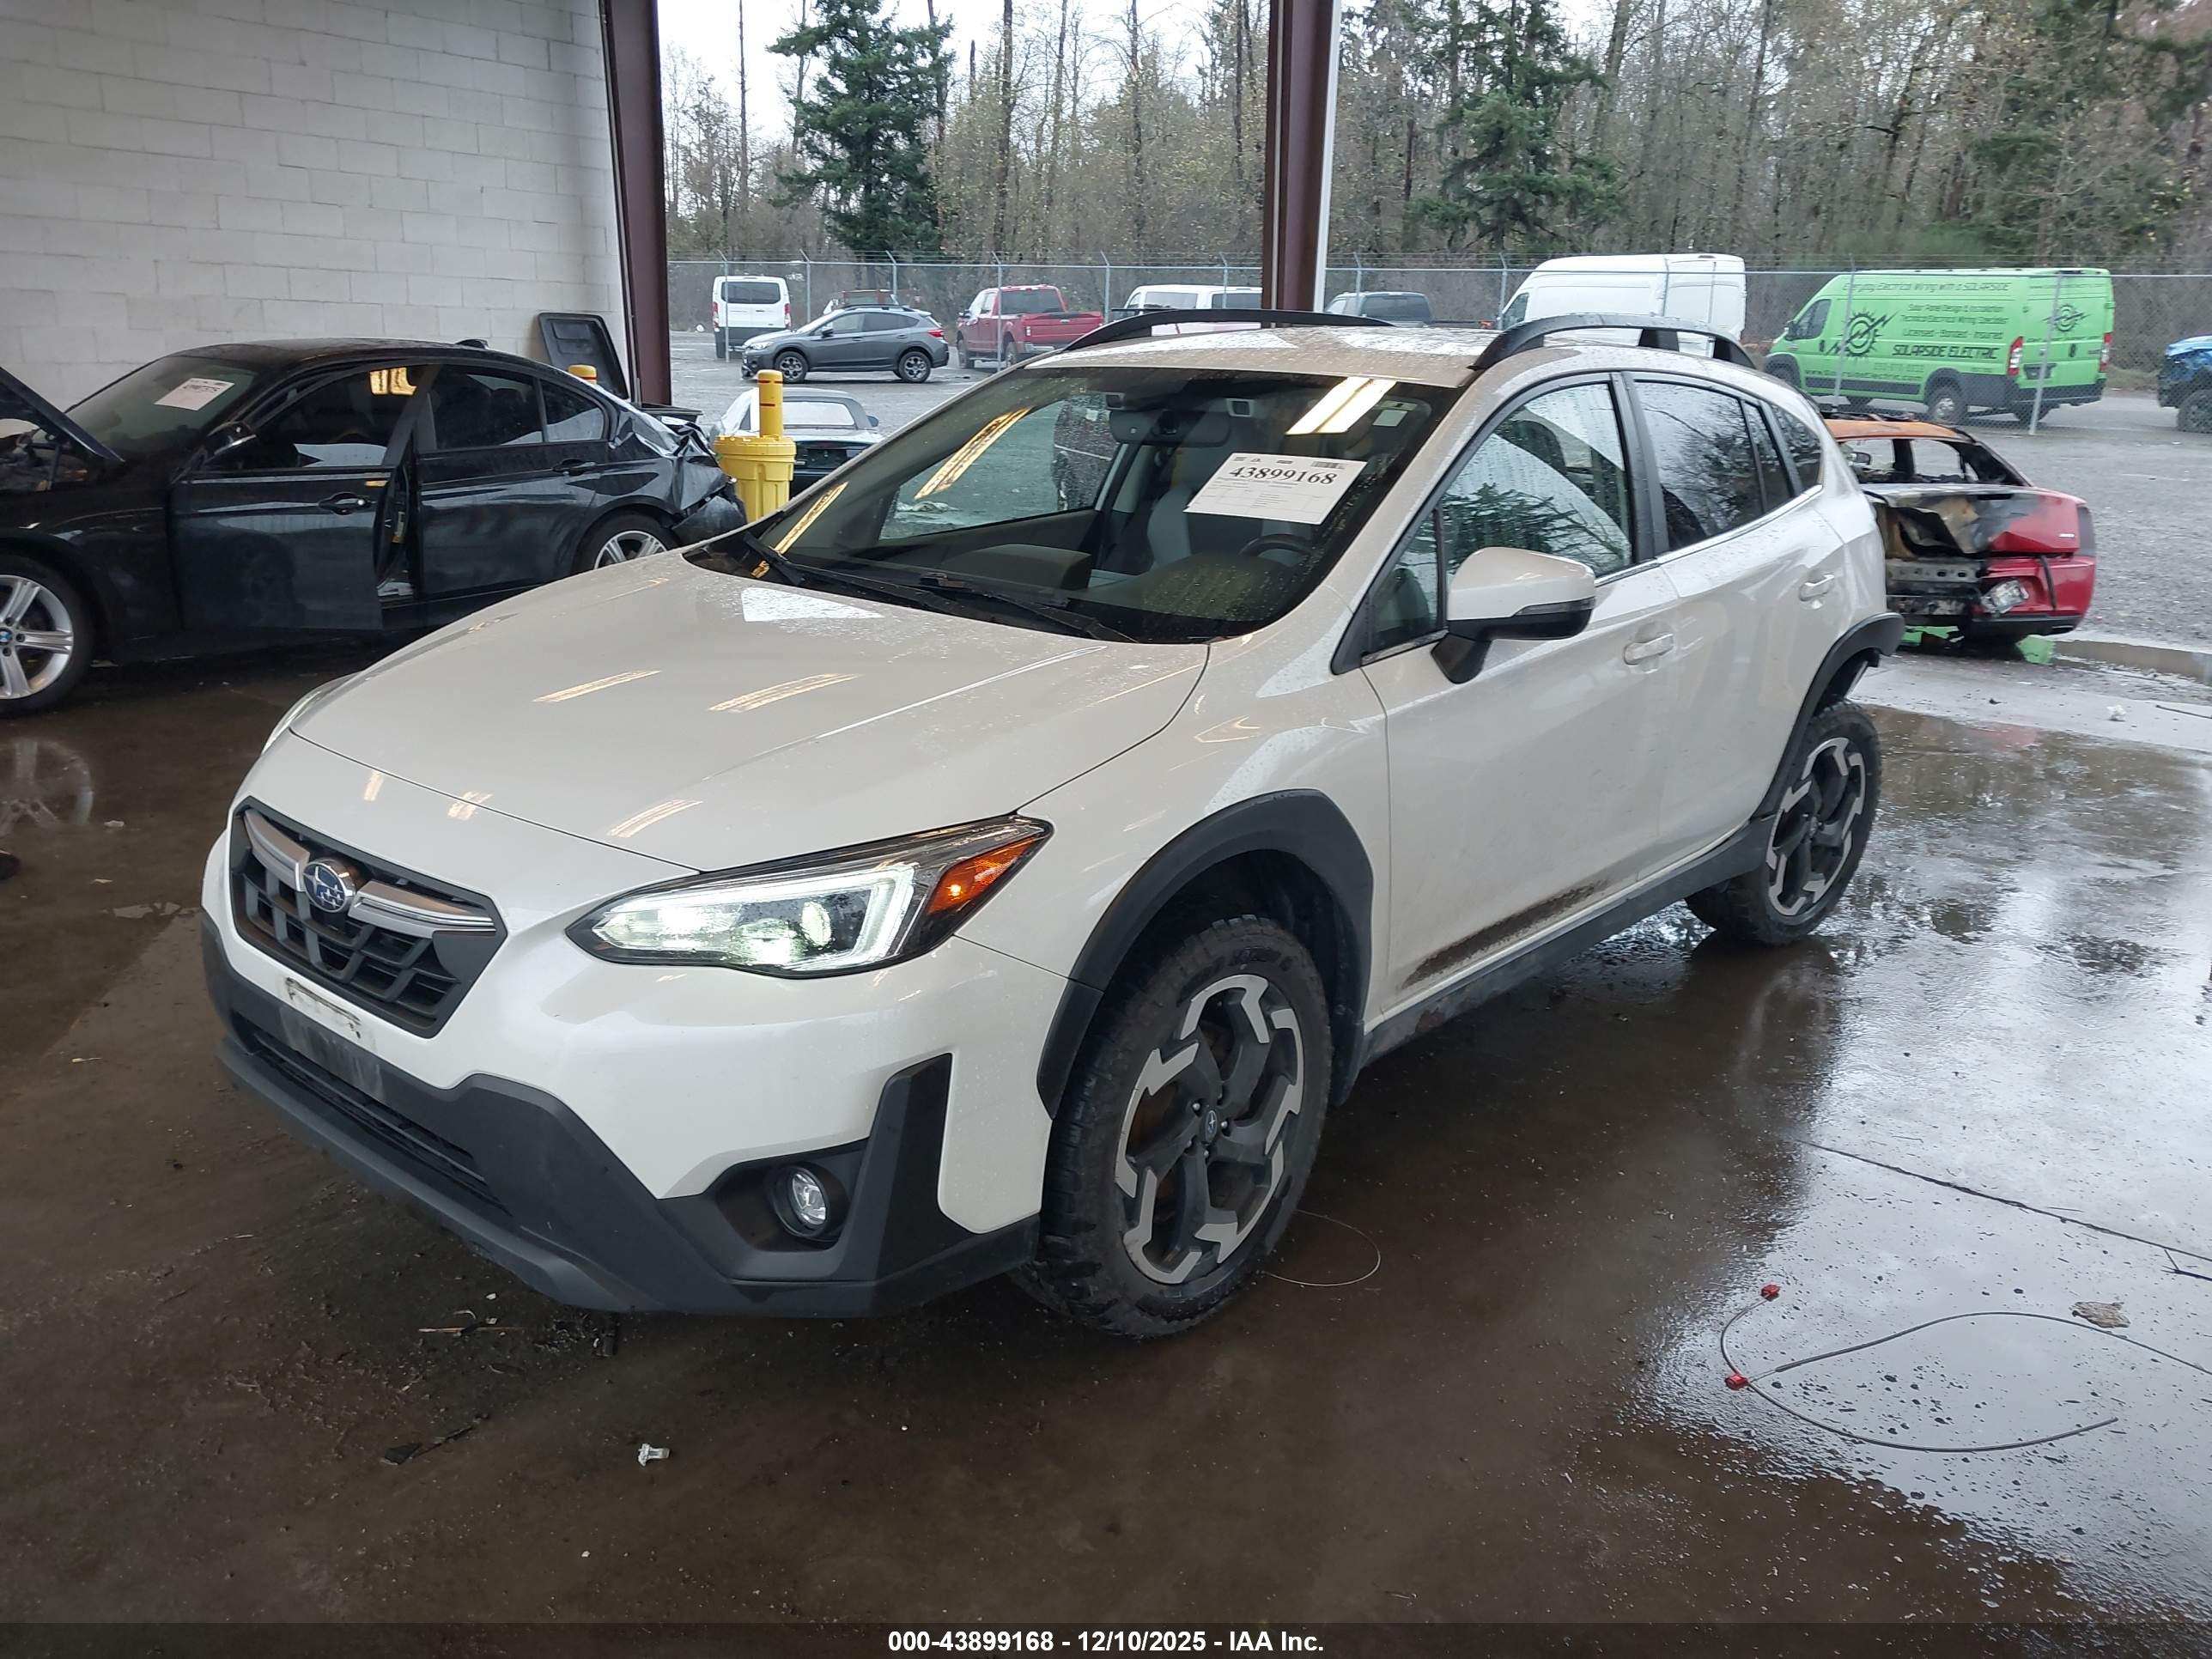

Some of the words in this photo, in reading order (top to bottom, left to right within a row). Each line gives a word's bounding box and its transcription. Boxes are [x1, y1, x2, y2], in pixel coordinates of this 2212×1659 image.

[1892, 344, 1947, 358] SOLARSIDE
[1947, 346, 2000, 360] ELECTRIC
[1230, 466, 1337, 485] 43899168
